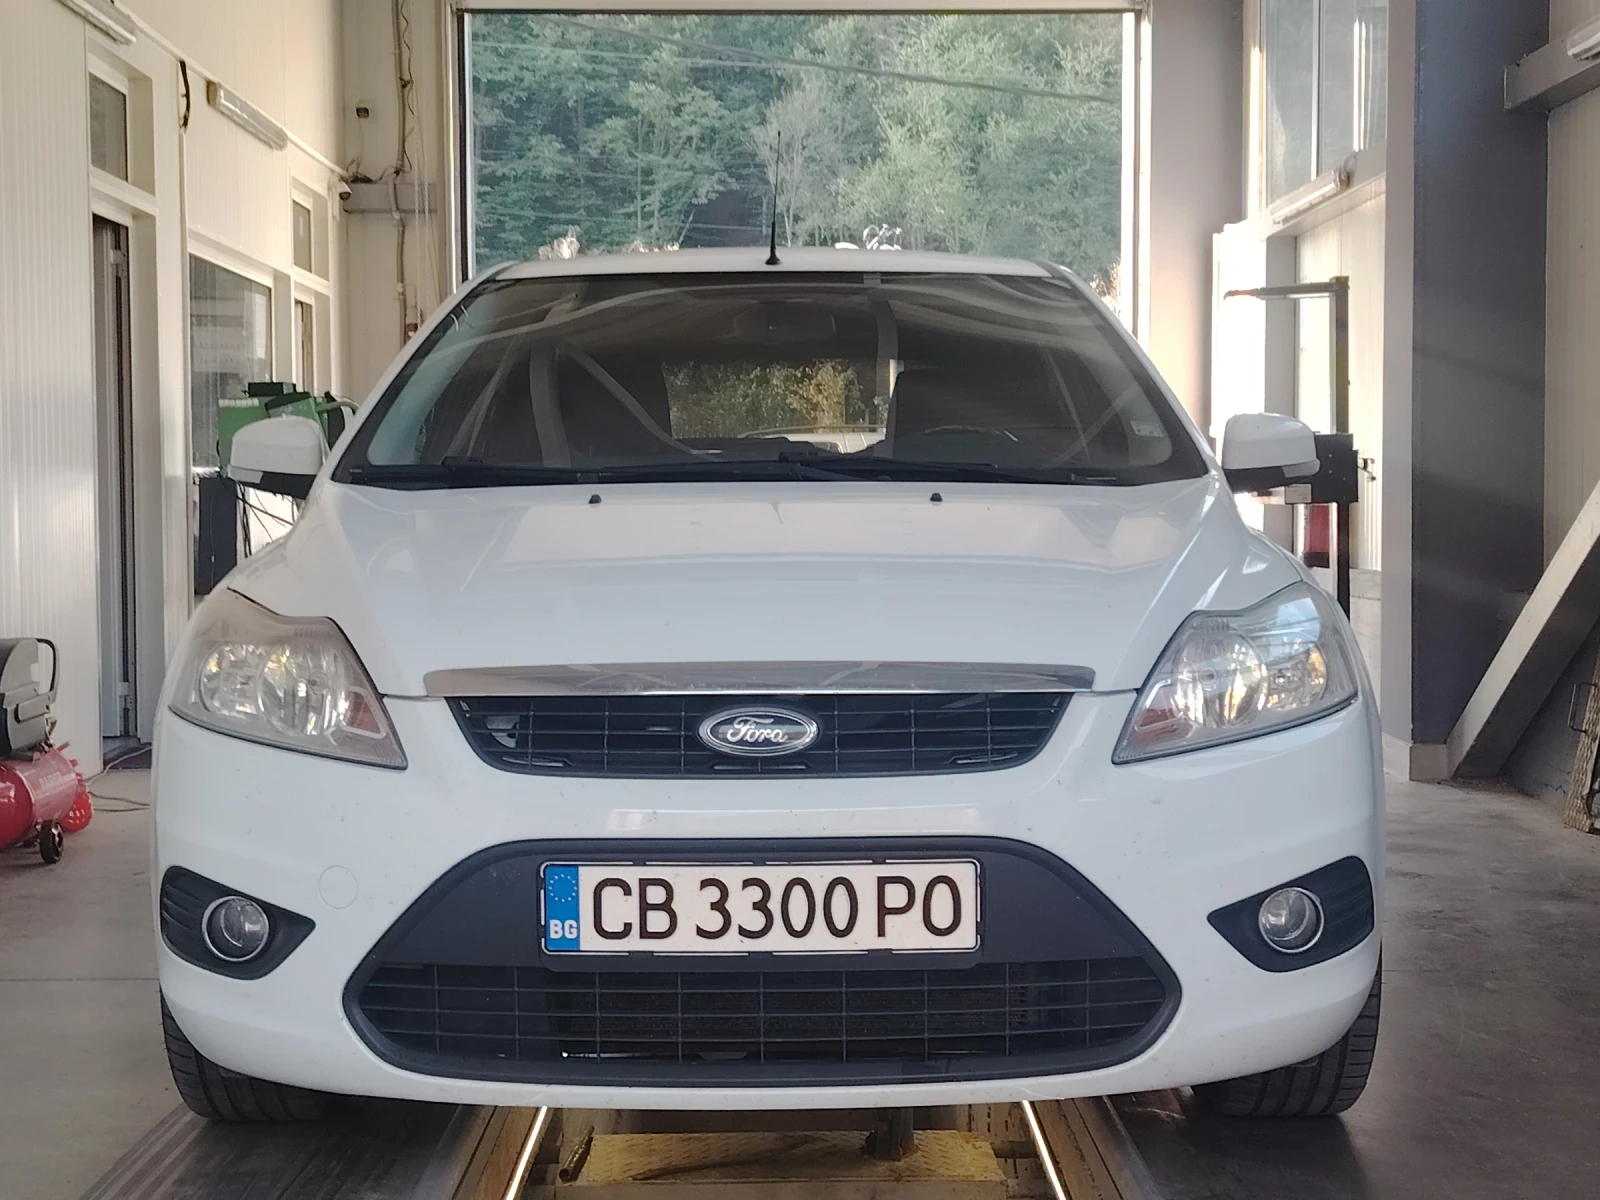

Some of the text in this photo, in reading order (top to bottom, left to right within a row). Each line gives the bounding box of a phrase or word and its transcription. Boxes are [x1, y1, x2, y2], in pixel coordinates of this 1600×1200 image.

[727, 716, 788, 743] Ford
[592, 877, 678, 939] CB
[695, 876, 859, 939] 3300
[549, 919, 578, 939] BG
